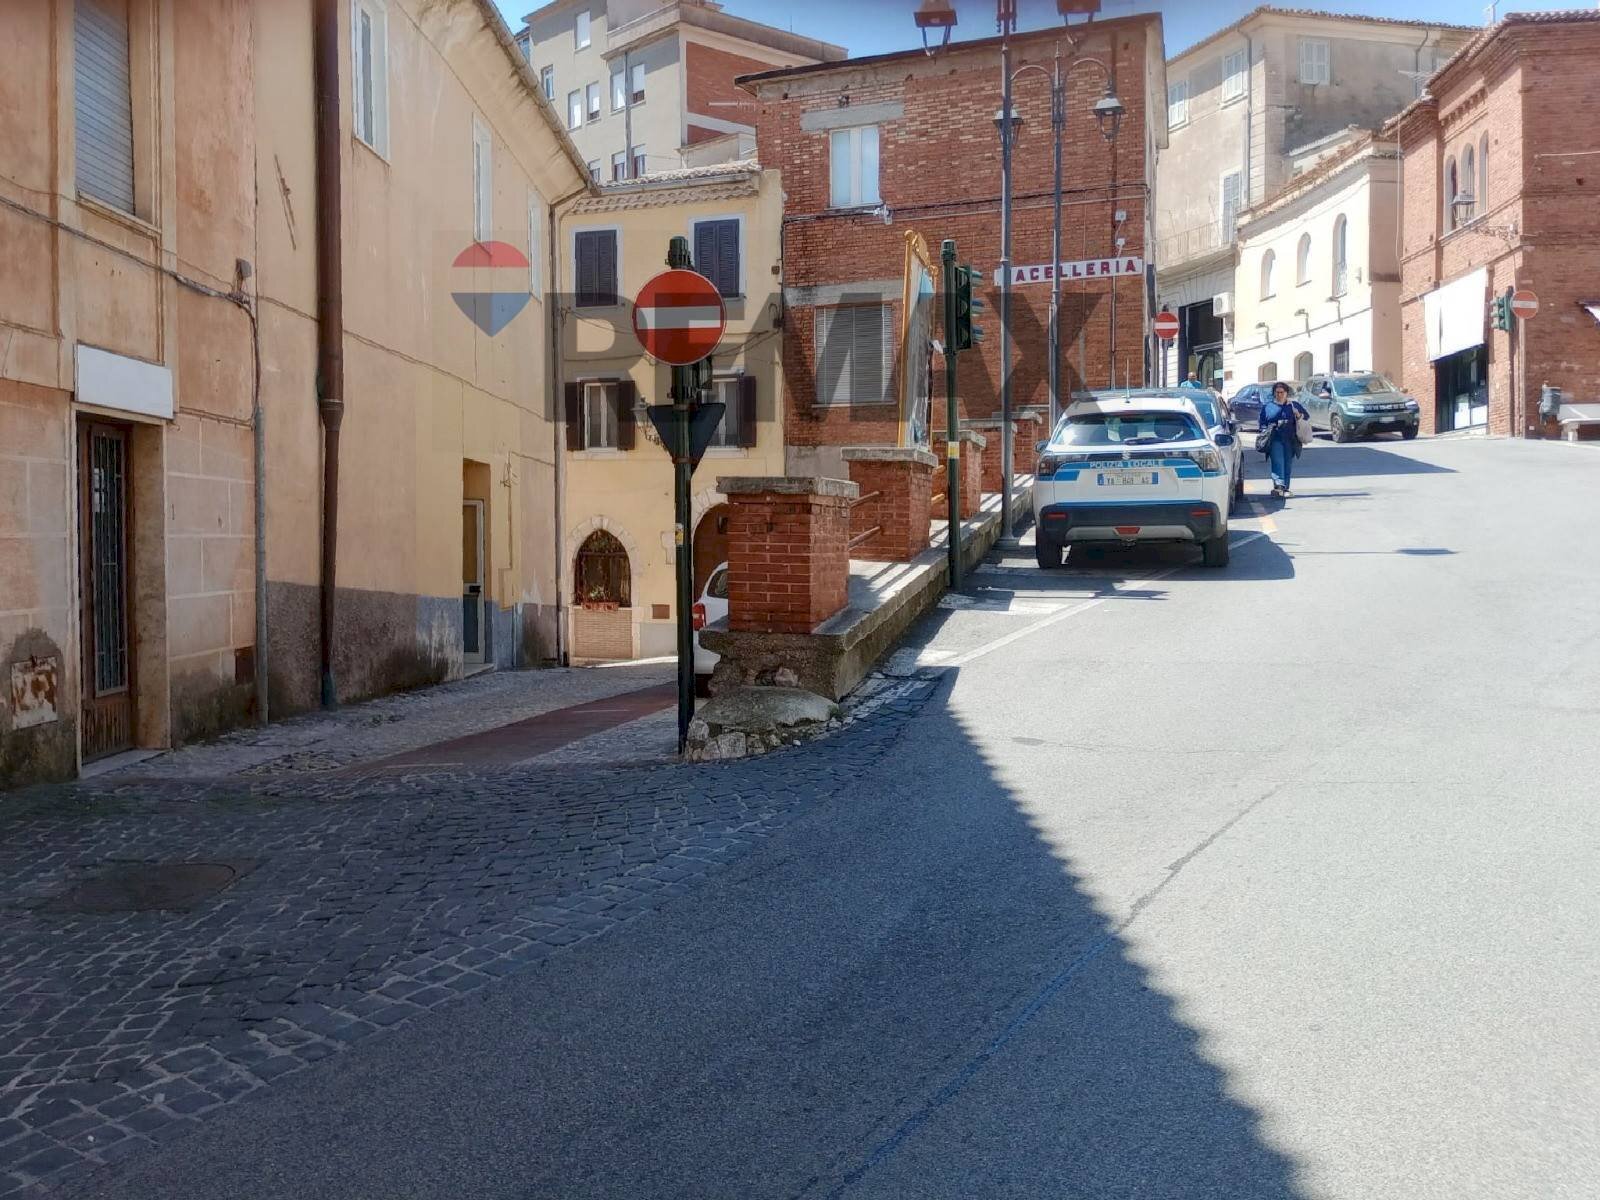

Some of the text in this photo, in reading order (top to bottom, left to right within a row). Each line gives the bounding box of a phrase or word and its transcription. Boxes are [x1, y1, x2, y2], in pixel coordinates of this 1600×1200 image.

[1004, 259, 1137, 283] ACELLERIA
[1089, 459, 1163, 469] POLIZIA LOCALE
